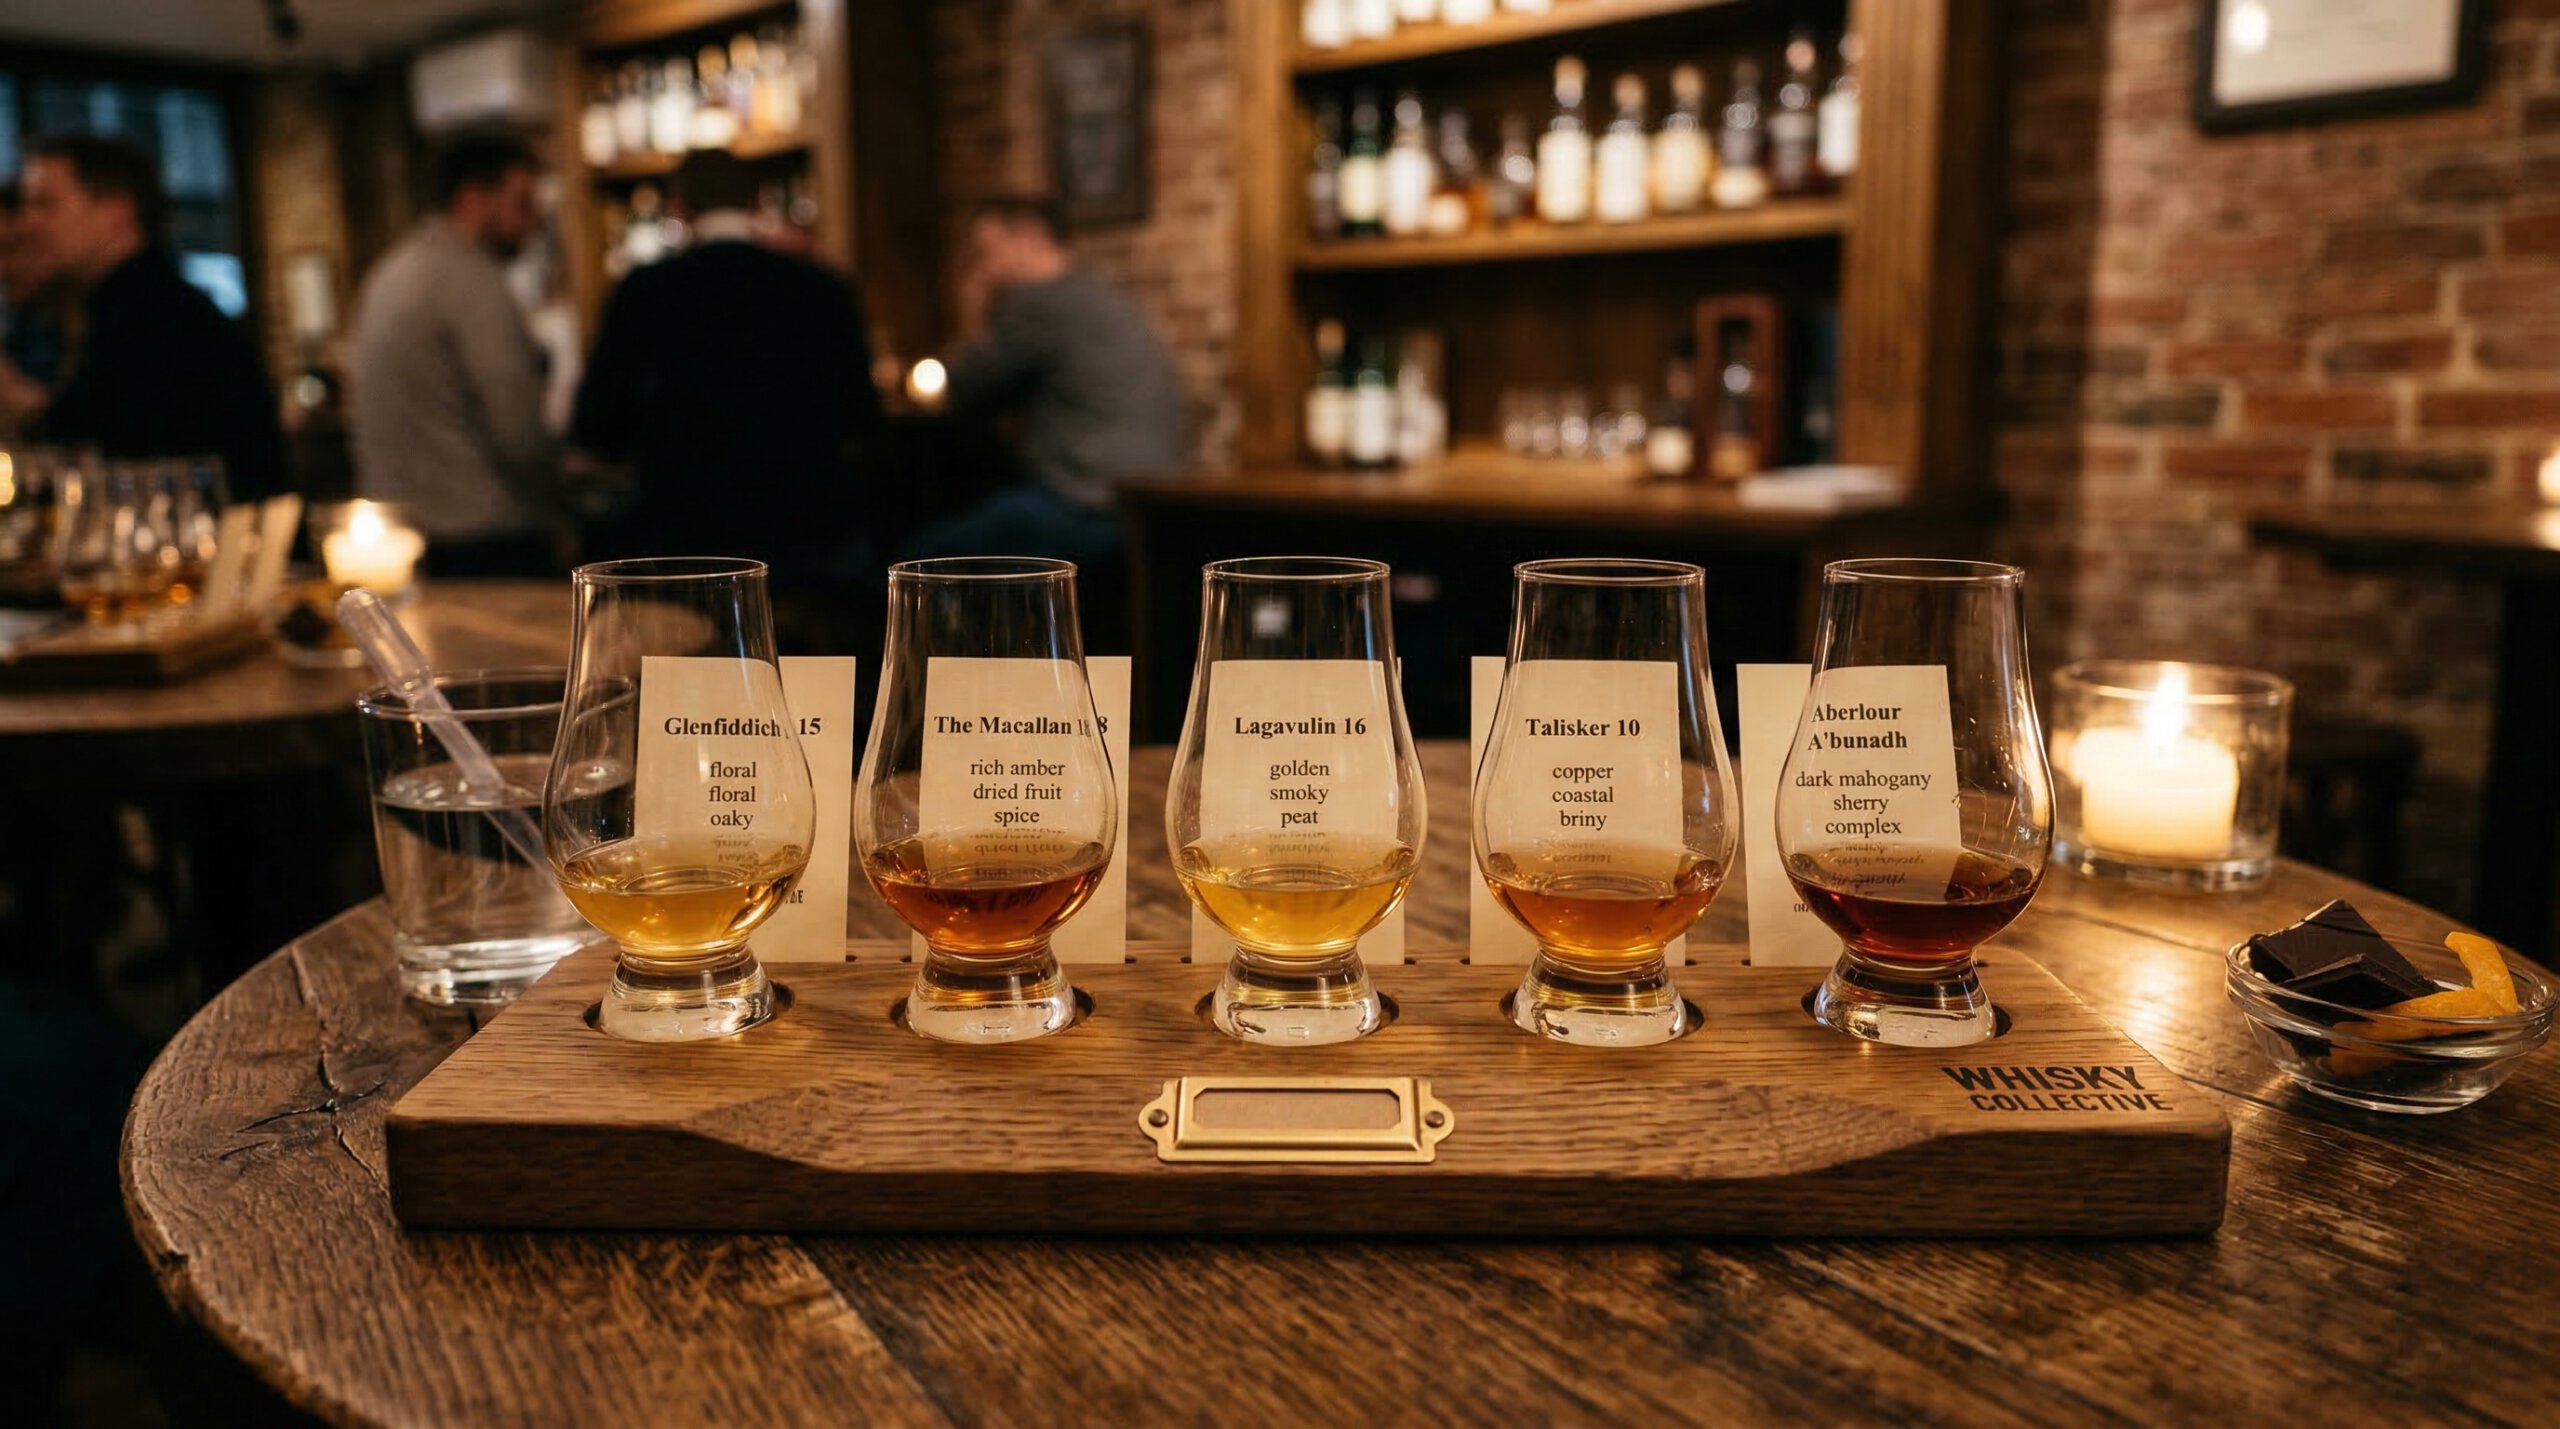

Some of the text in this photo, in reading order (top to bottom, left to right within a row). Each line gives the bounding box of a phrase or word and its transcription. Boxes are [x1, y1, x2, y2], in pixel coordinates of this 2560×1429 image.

[1811, 703, 1902, 723] Aberlour
[664, 716, 822, 738] Glenfiddich 15
[933, 715, 973, 735] The
[979, 715, 1073, 736] Macallan
[1234, 716, 1367, 740] Lagavulin 16
[1525, 717, 1641, 737] Talisker 10
[1807, 731, 1908, 751] A'bunadh
[709, 760, 757, 779] floral
[970, 758, 1066, 777] rich amber
[1269, 759, 1330, 781] golden
[1551, 765, 1614, 780] copper
[1795, 769, 1932, 790] dark mahogany
[708, 785, 756, 803] floral
[972, 782, 1063, 801] dried fruit
[1269, 783, 1330, 805] smoky
[1551, 786, 1614, 804] coastal
[1832, 794, 1890, 814] sherry
[709, 809, 754, 831] oaky
[993, 806, 1041, 827] spice
[1280, 810, 1319, 829] peat
[1559, 810, 1607, 831] briny
[1824, 817, 1903, 838] complex
[1941, 1065, 2145, 1091] WHISKY
[1969, 1094, 2174, 1112] COLLECTIVE
